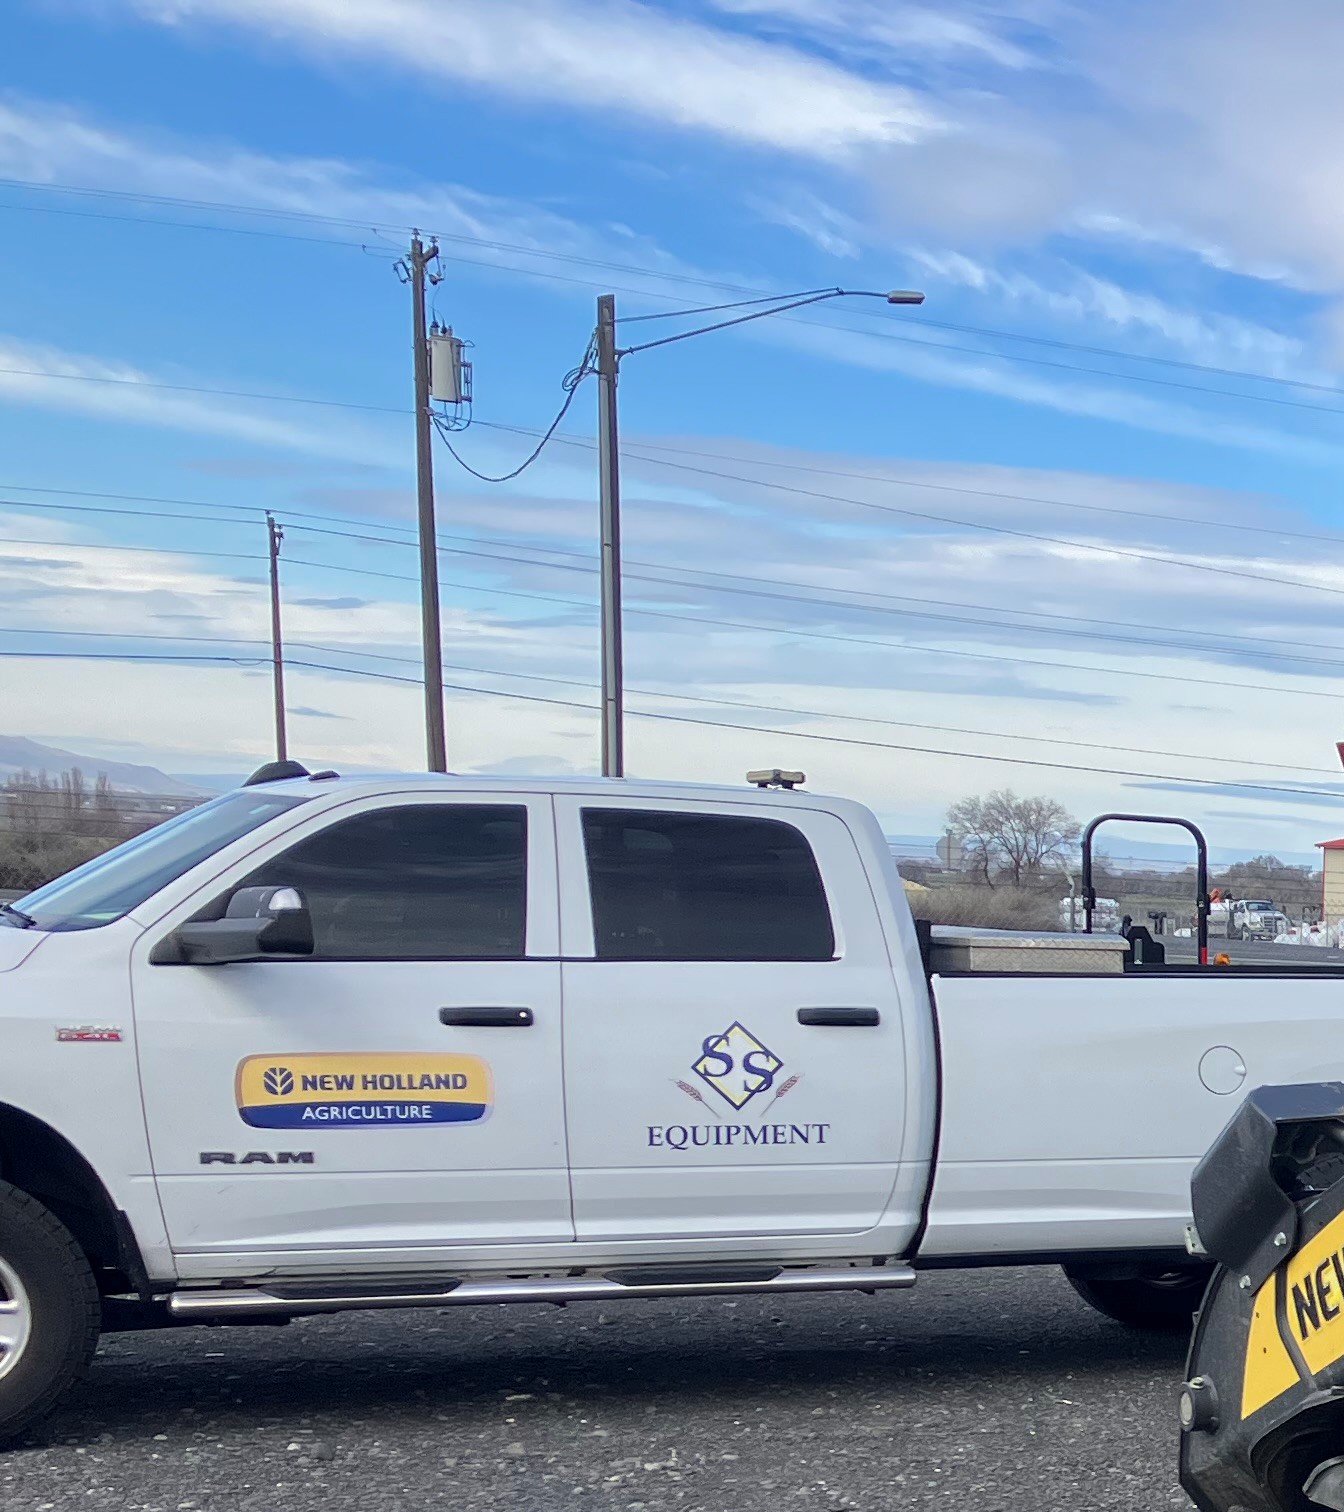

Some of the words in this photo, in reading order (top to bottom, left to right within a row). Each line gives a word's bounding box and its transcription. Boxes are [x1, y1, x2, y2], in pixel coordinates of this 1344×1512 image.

[301, 1074, 355, 1091] NEW
[361, 1073, 468, 1090] HOLLAND
[302, 1105, 433, 1120] AGRICULTURE
[647, 1123, 830, 1150] EQUIPMENT
[200, 1152, 314, 1165] RAM
